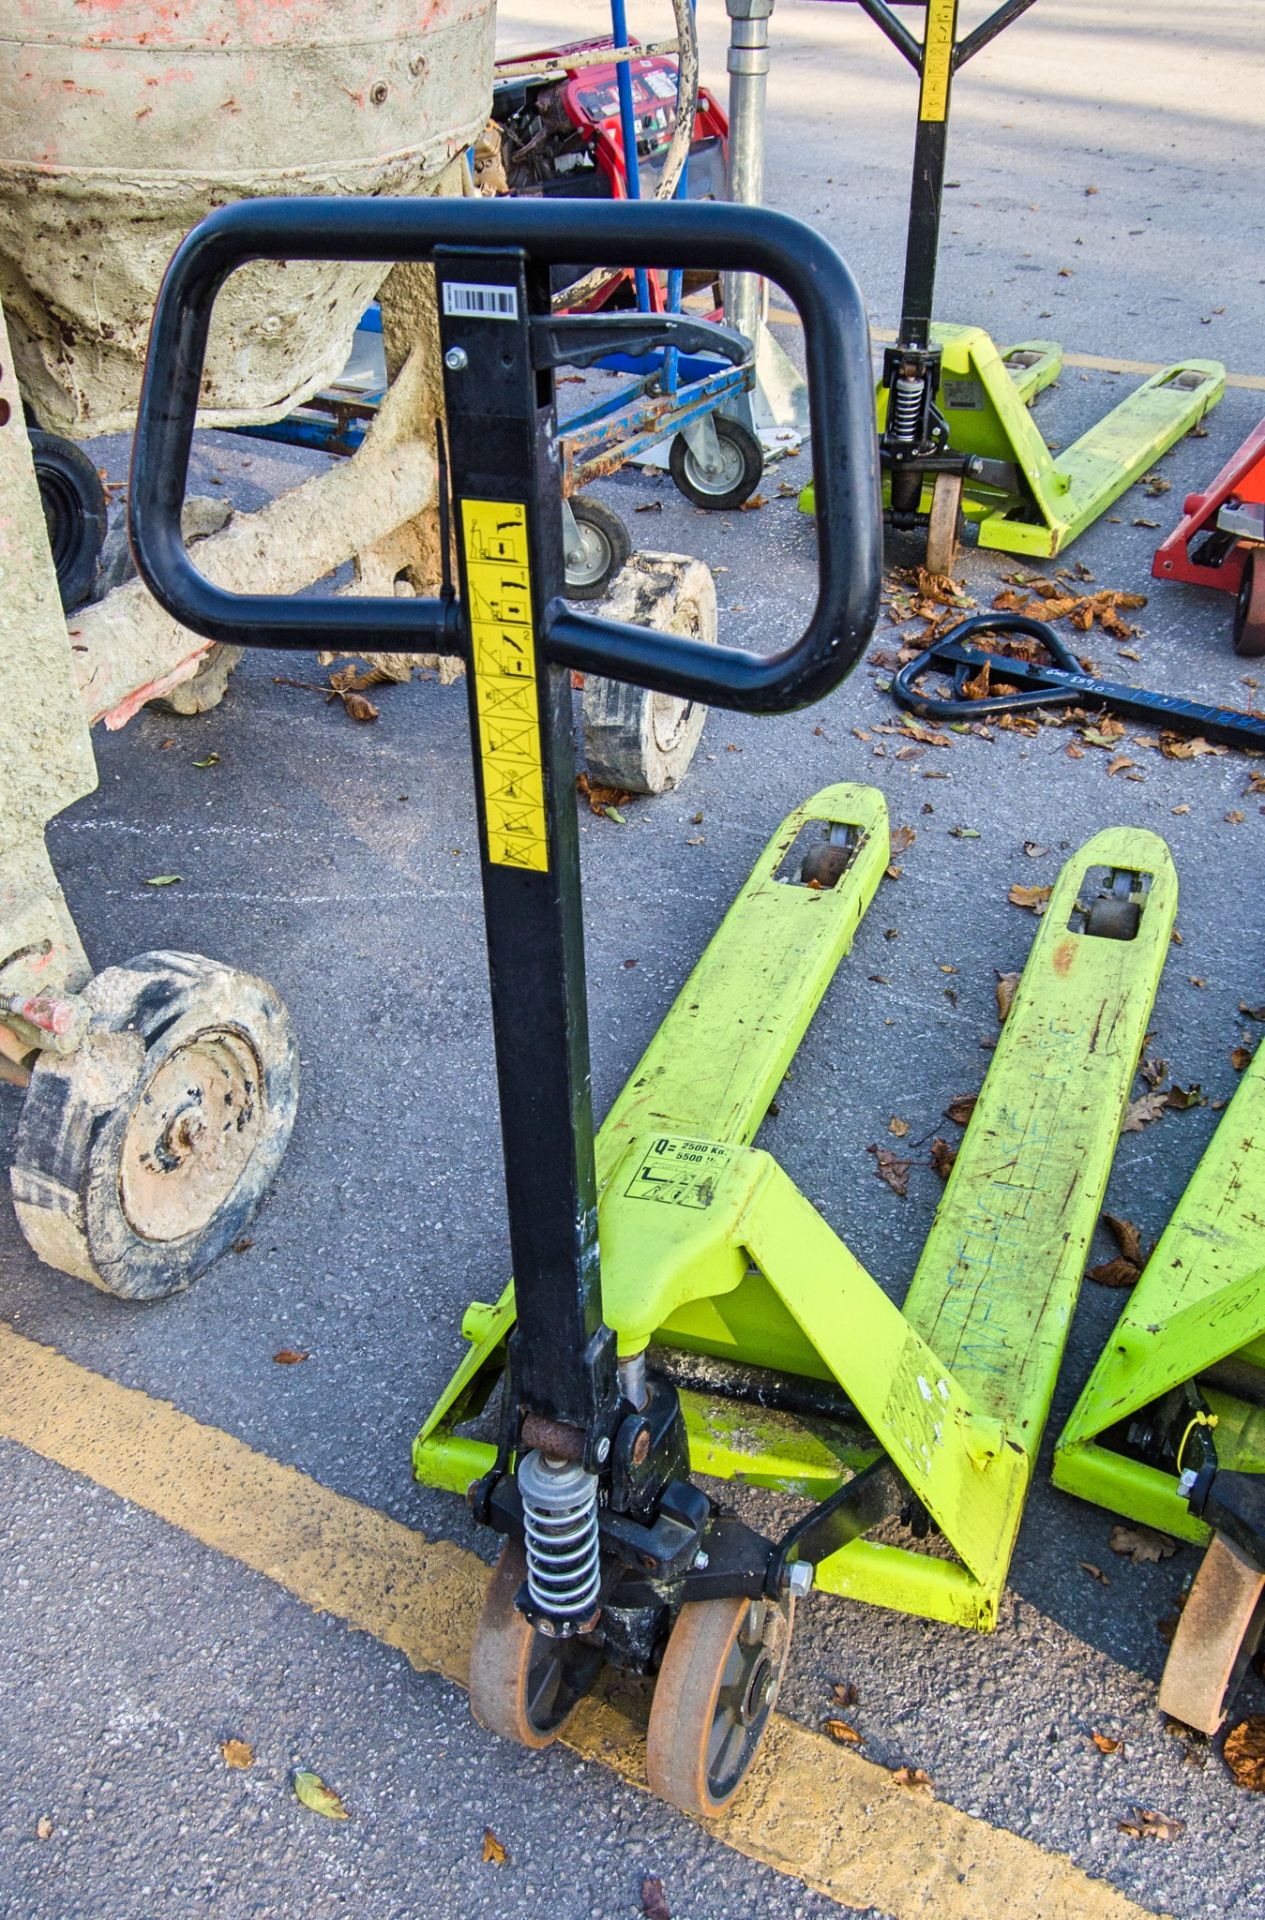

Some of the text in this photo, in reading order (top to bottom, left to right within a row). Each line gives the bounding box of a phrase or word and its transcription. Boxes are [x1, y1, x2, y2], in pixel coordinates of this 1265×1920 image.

[515, 507, 522, 518] 3
[523, 630, 530, 641] 2
[681, 1142, 708, 1153] 2500
[676, 1152, 703, 1163] 5500
